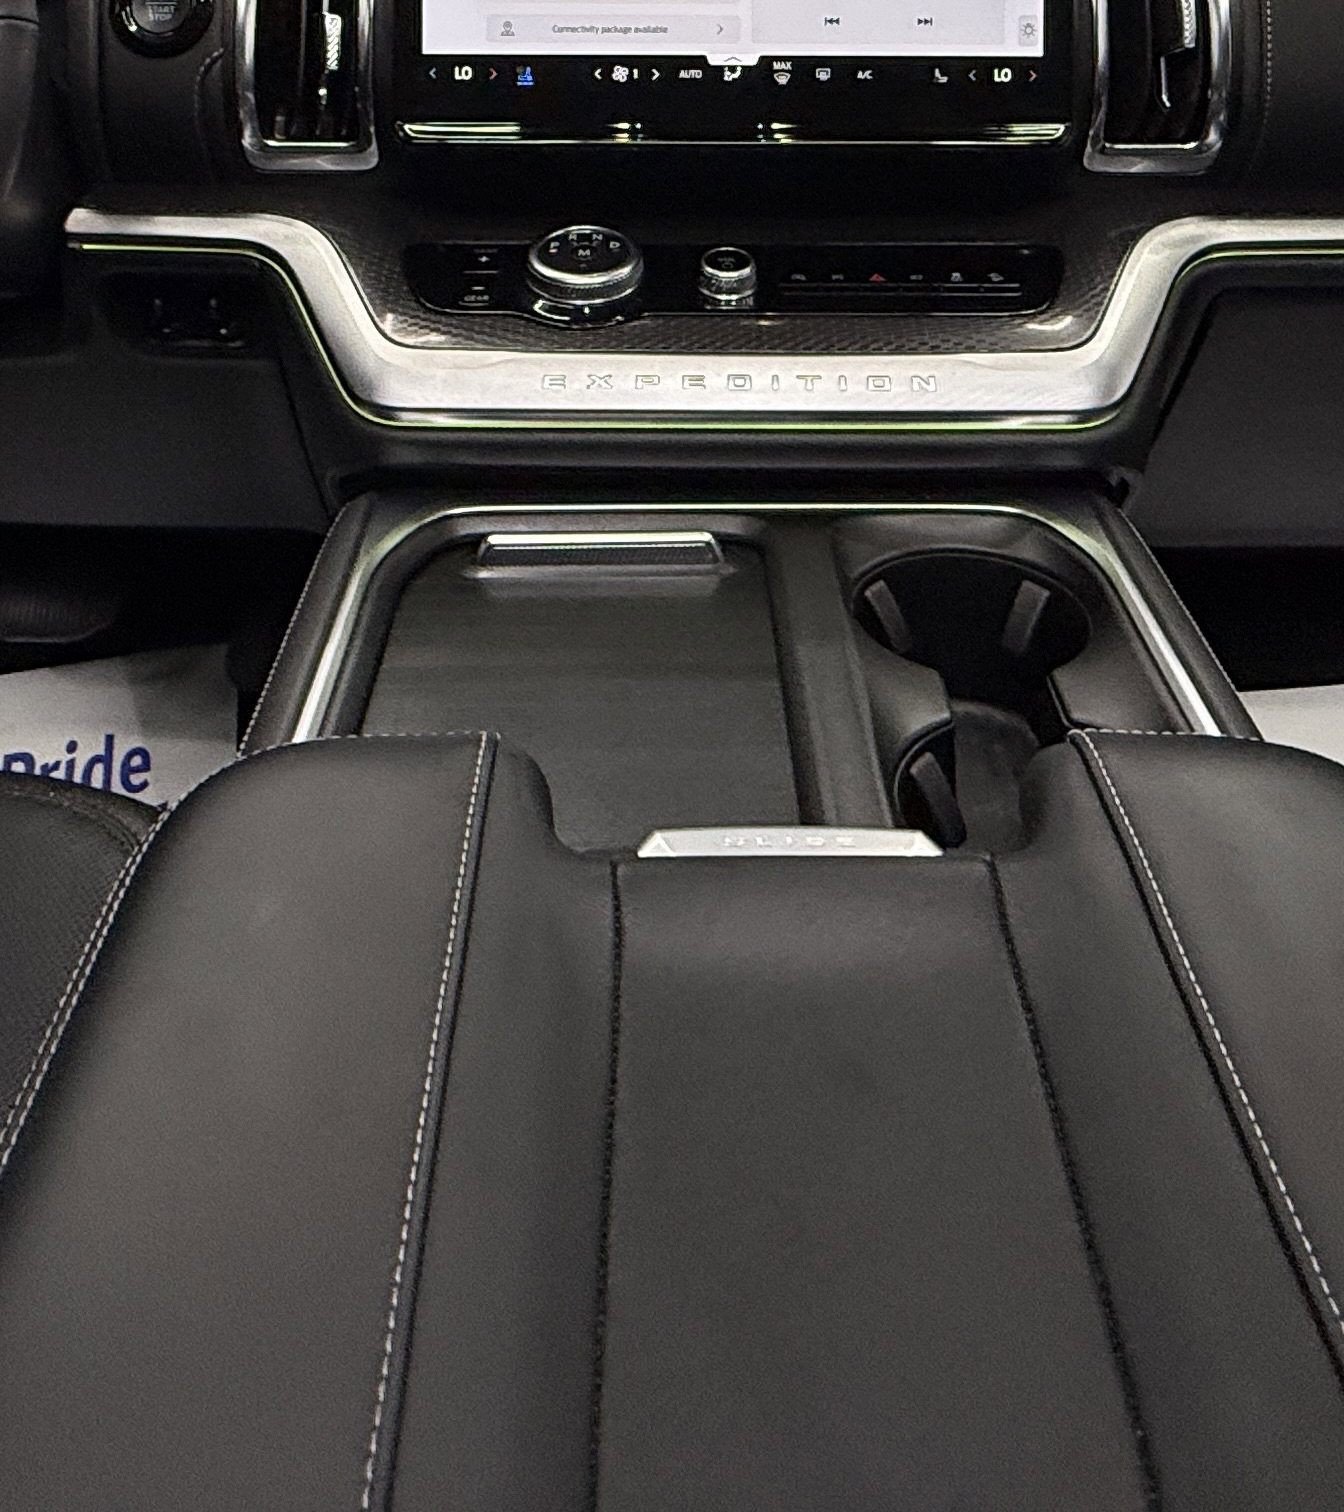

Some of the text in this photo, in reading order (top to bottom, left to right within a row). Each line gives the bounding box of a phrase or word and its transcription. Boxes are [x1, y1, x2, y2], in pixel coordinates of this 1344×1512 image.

[552, 24, 669, 35] Connectivity package available
[772, 61, 792, 71] MAX
[454, 66, 472, 80] LO
[679, 69, 703, 79] AUTO
[856, 69, 873, 80] A/C
[993, 68, 1012, 82] LO
[577, 248, 590, 257] M
[541, 373, 938, 393] EXPEDITION
